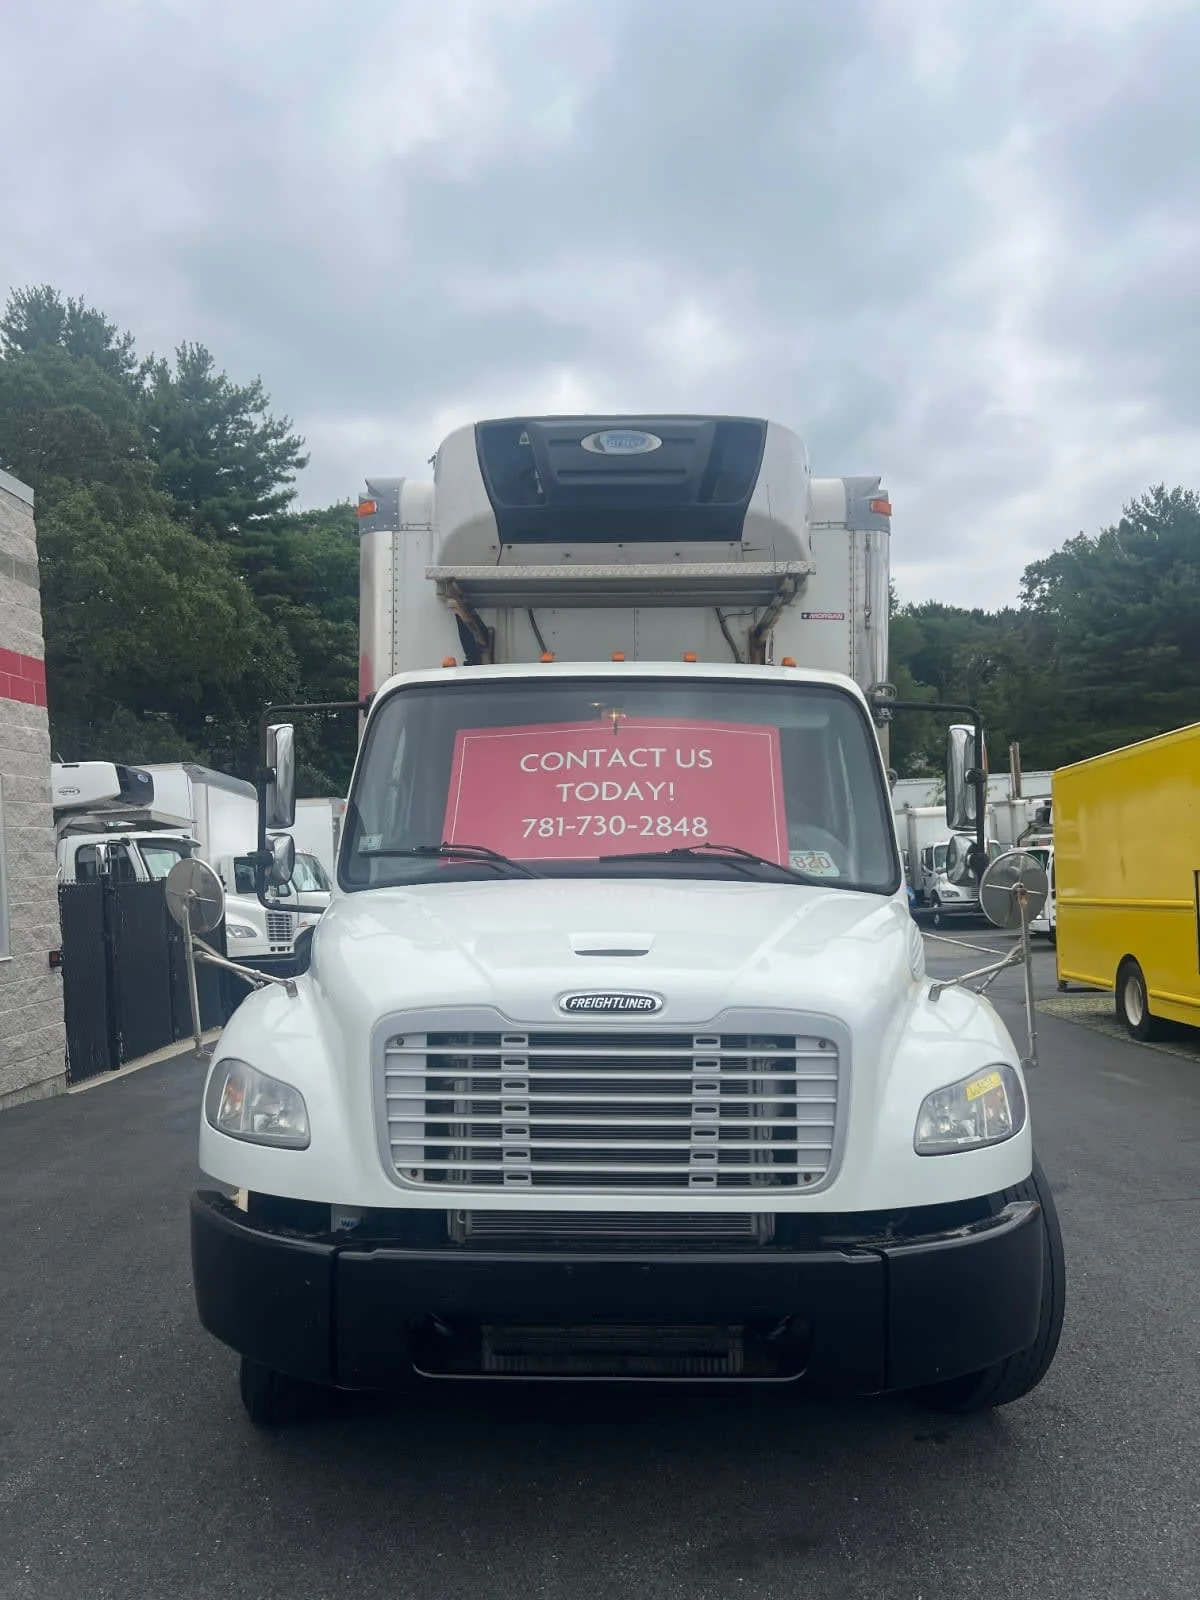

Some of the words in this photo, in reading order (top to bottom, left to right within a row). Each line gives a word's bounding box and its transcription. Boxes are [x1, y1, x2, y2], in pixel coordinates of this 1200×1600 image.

[520, 748, 667, 772] CONTACT
[676, 748, 713, 768] US
[556, 781, 675, 802] TODAY!
[522, 815, 708, 838] 781-730-2848
[569, 997, 652, 1009] FREIGHTLINER
